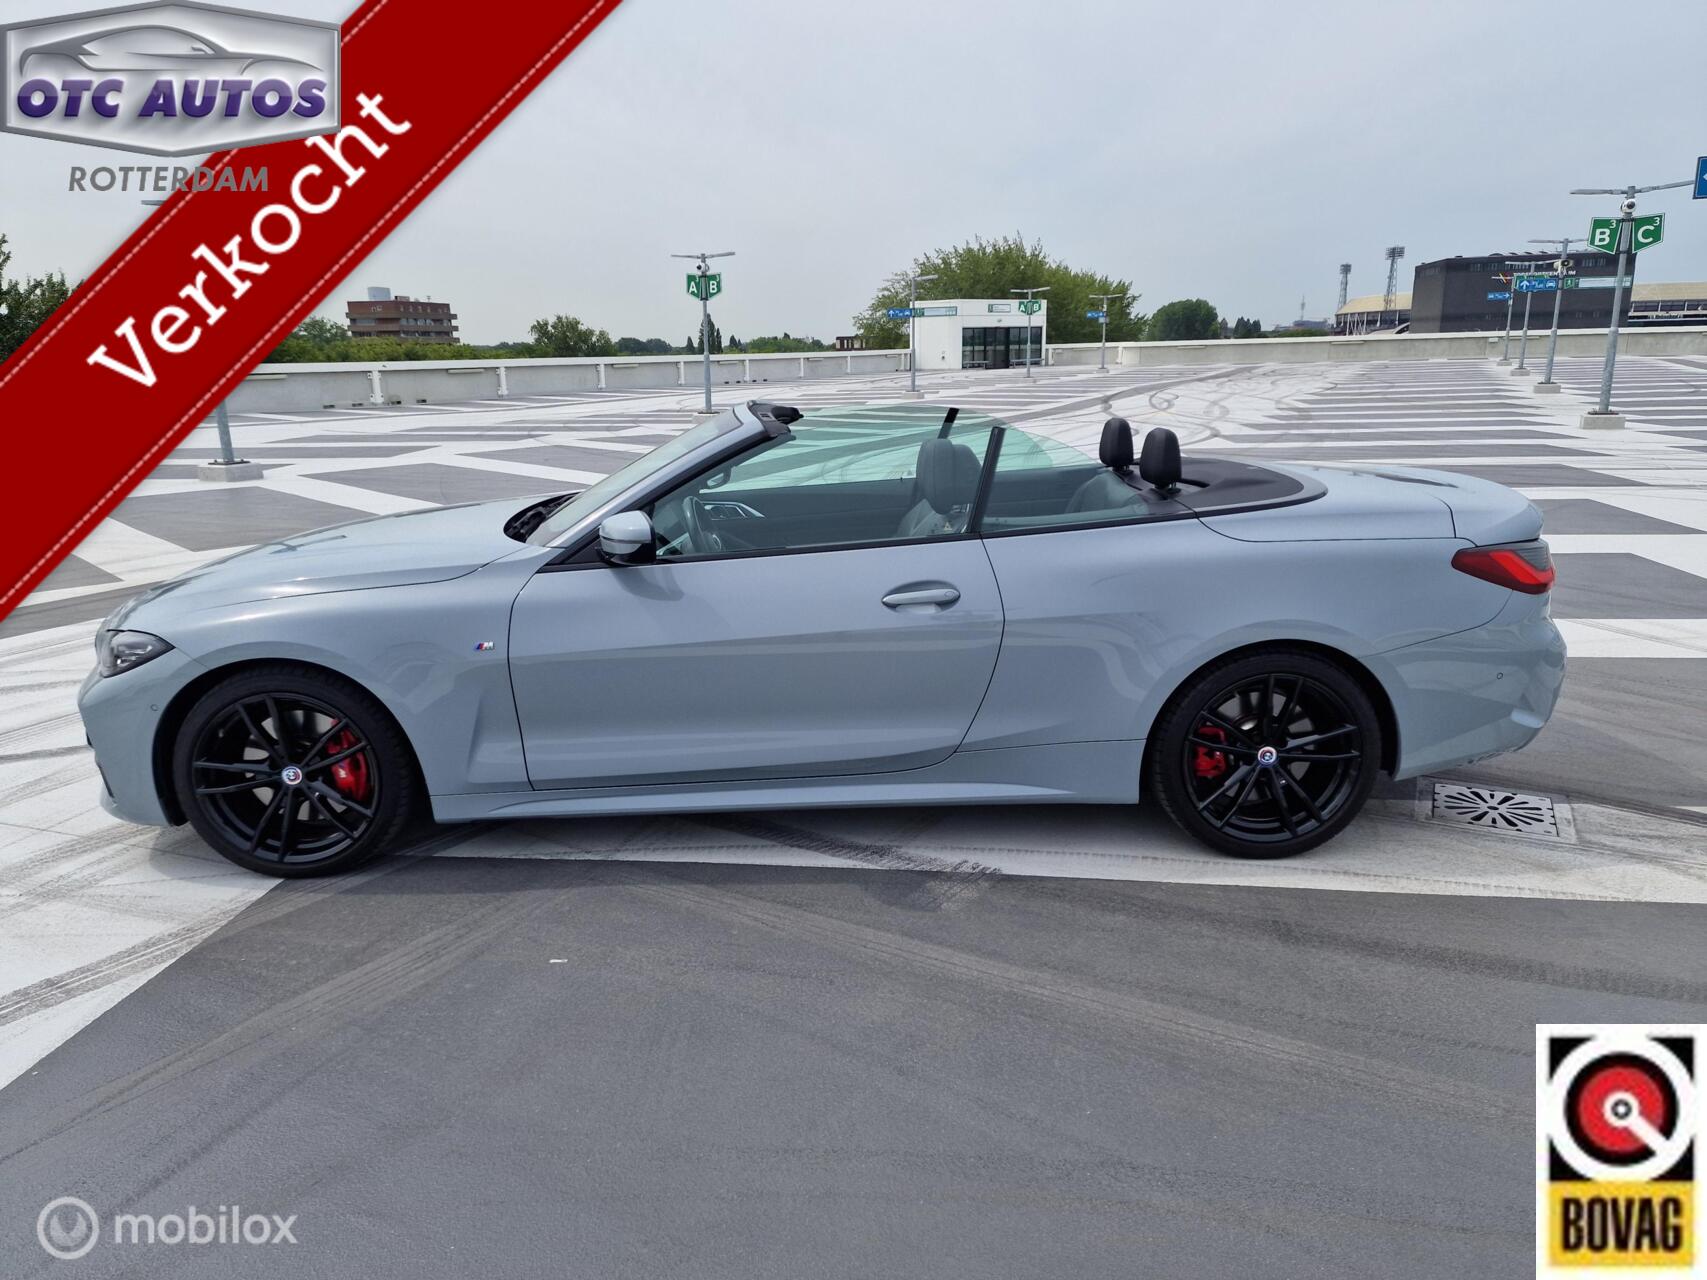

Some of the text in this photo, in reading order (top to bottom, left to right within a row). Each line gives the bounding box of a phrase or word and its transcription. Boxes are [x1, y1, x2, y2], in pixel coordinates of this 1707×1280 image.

[1594, 228, 1611, 246] B
[1637, 225, 1655, 243] C
[689, 281, 697, 293] A
[710, 281, 717, 293] B
[1020, 304, 1026, 312] A
[1033, 303, 1039, 311] B
